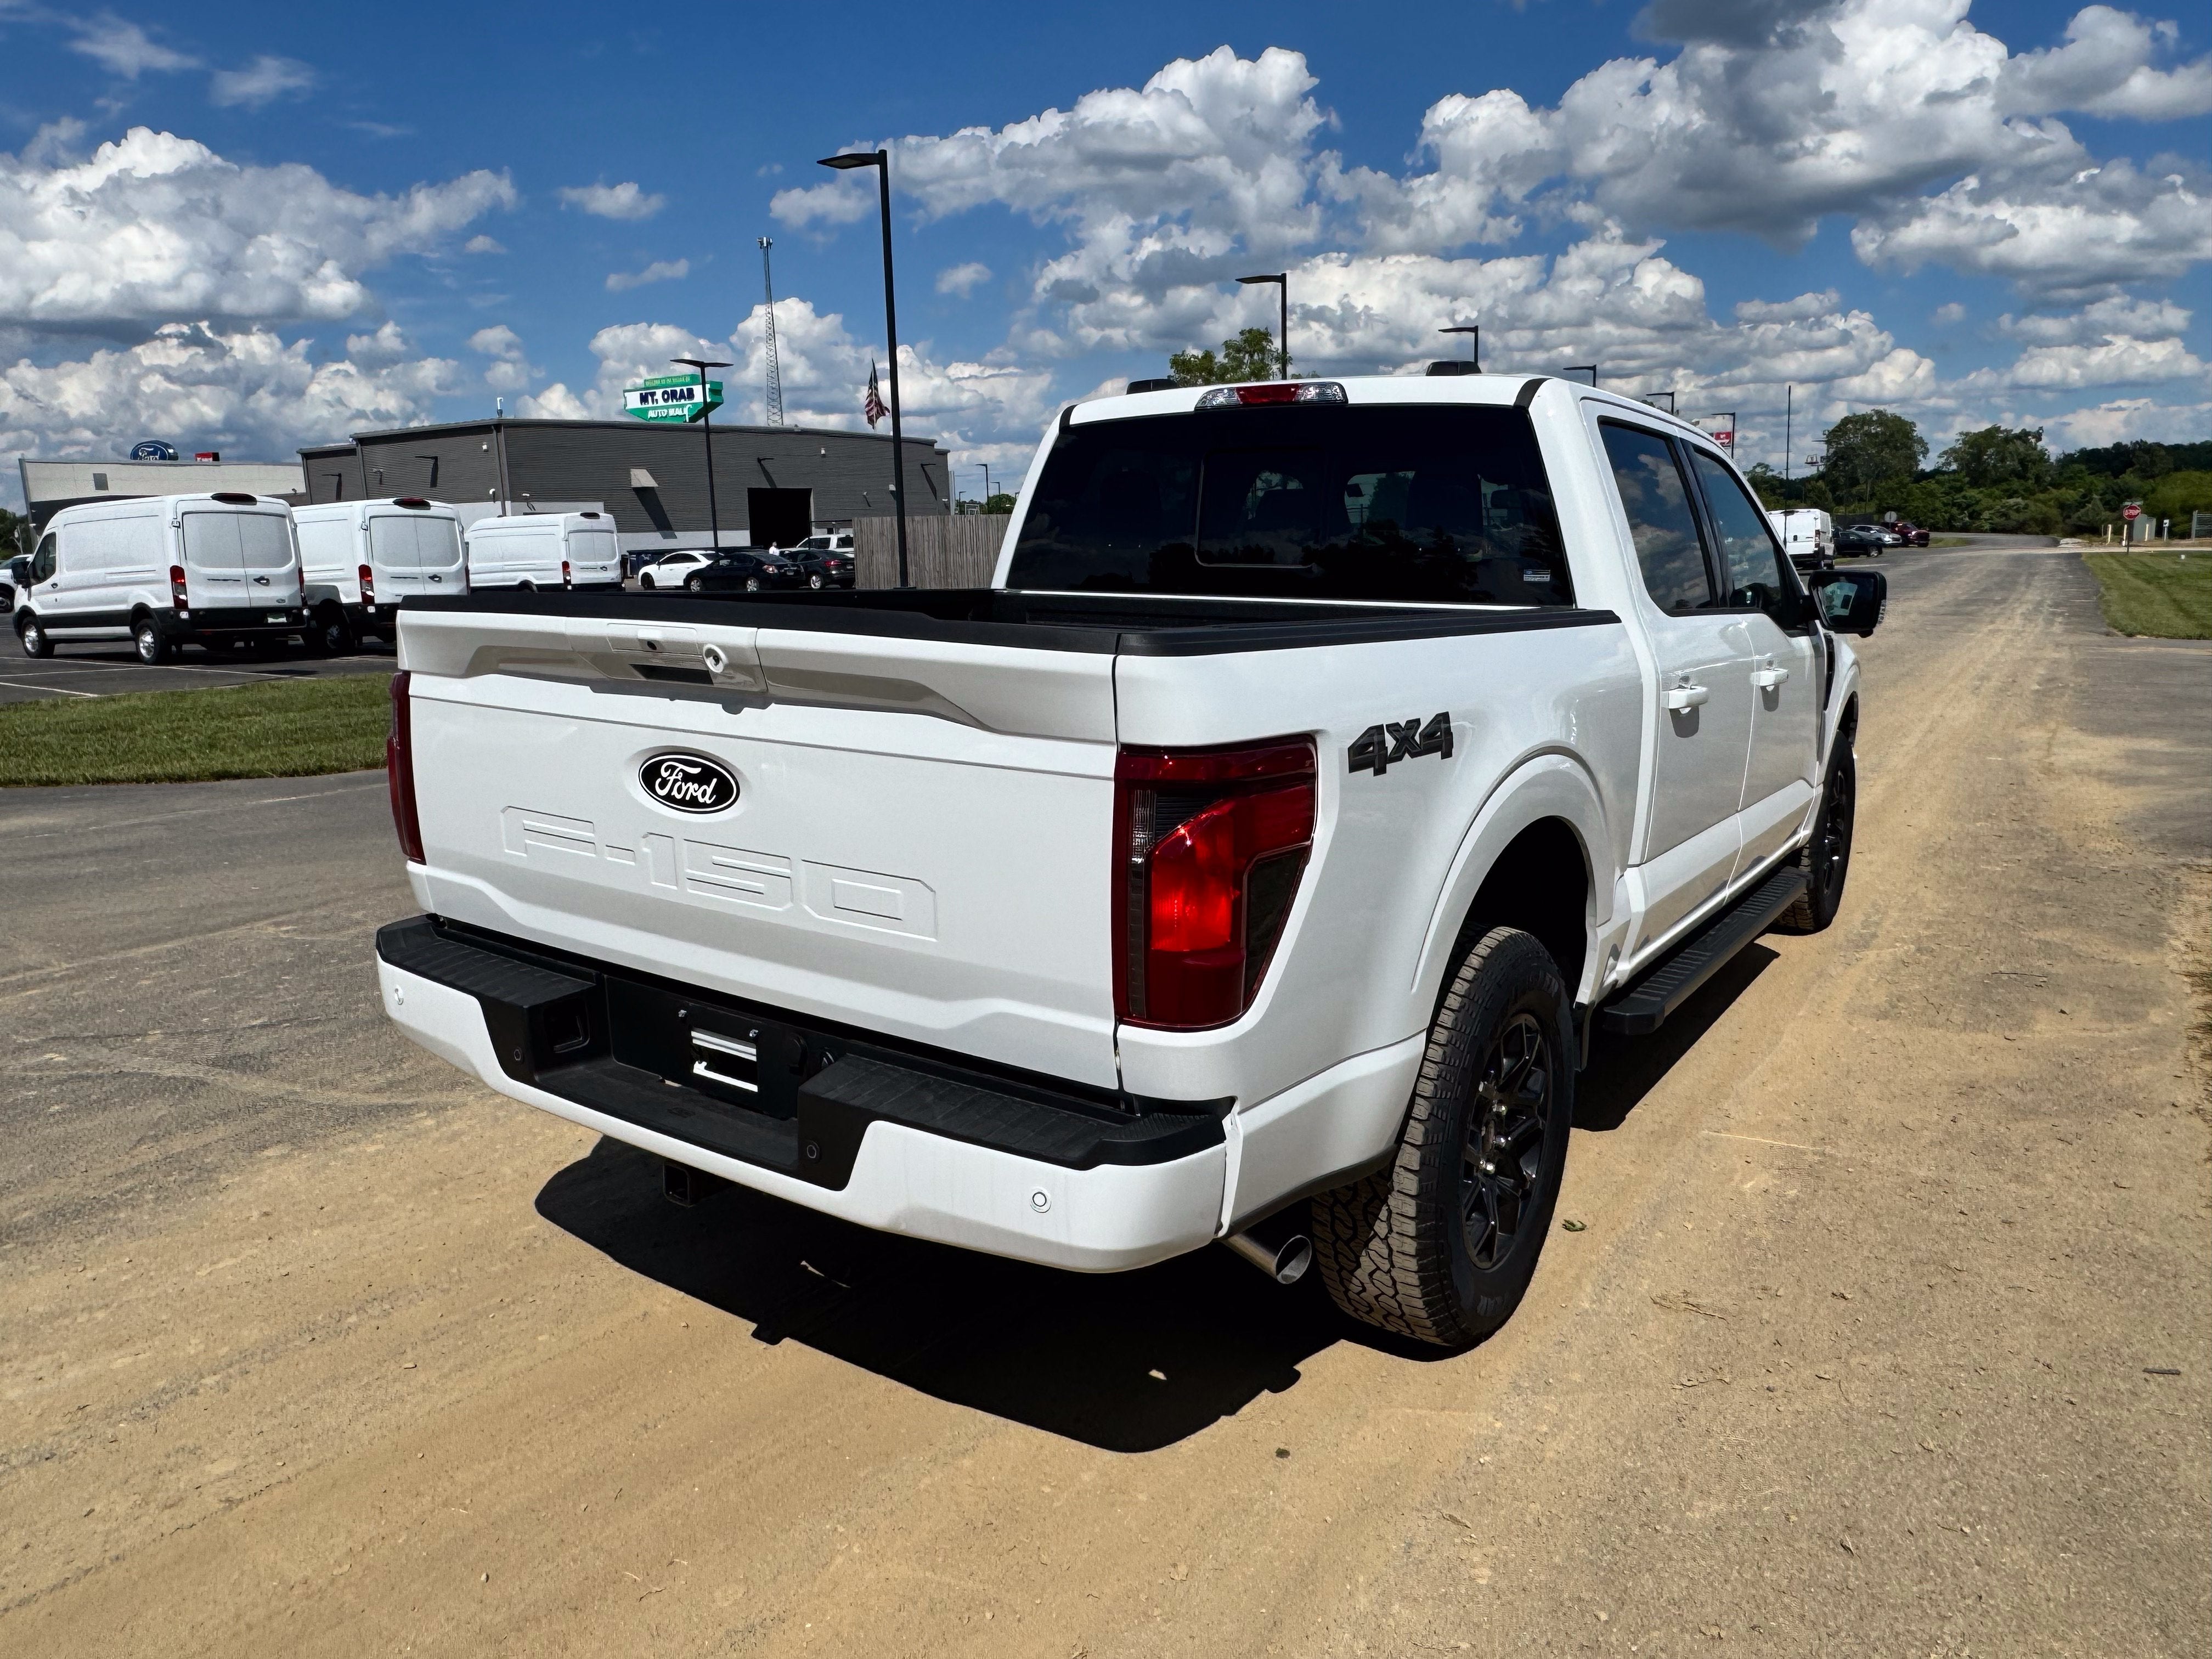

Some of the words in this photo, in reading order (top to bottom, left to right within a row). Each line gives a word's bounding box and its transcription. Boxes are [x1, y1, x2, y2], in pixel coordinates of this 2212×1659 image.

[640, 391, 658, 405] MT.
[662, 388, 695, 403] ORAB
[648, 409, 668, 419] AUTO
[655, 761, 717, 804] Ford
[500, 805, 937, 942] F-150
